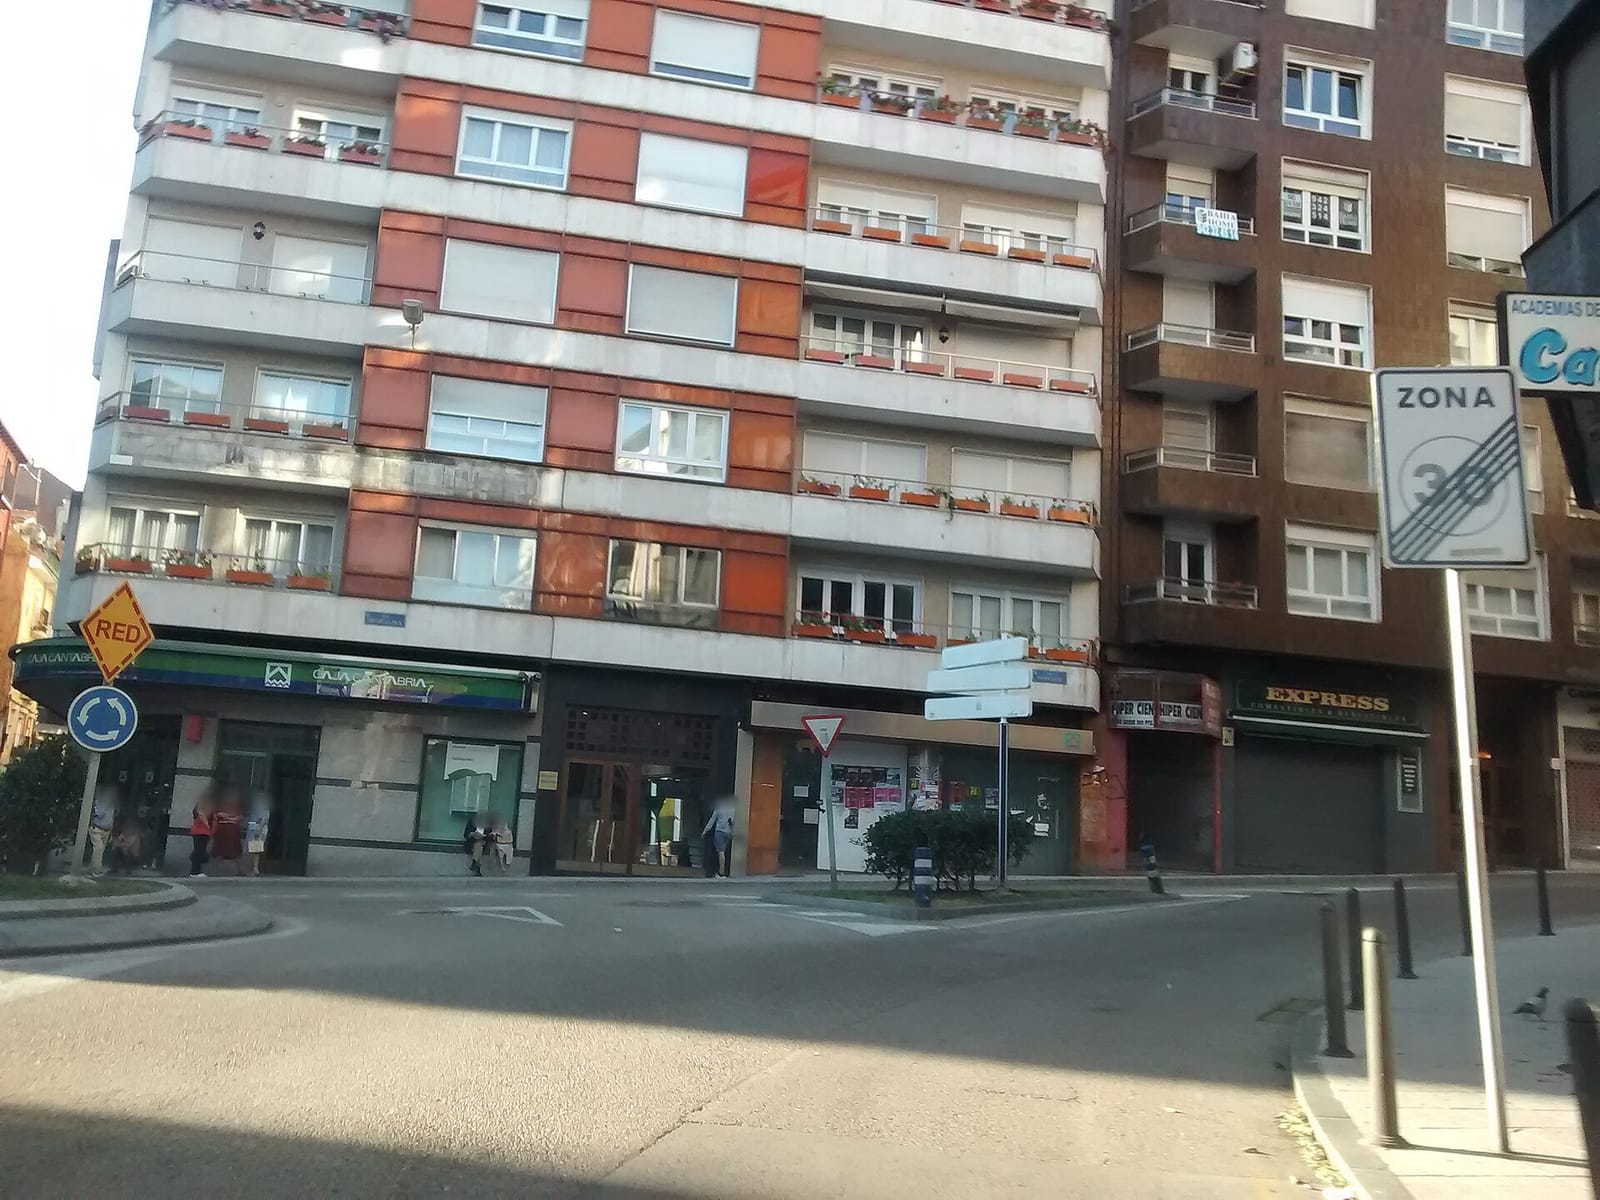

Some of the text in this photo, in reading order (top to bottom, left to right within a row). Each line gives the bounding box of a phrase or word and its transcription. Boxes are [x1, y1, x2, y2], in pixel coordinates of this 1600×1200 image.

[1512, 299, 1583, 317] ACADEMIAS
[1519, 327, 1600, 386] Ca
[1397, 386, 1496, 408] ZONA
[95, 619, 141, 644] RED
[312, 667, 350, 682] CAJA
[1266, 686, 1390, 712] EXPRESS
